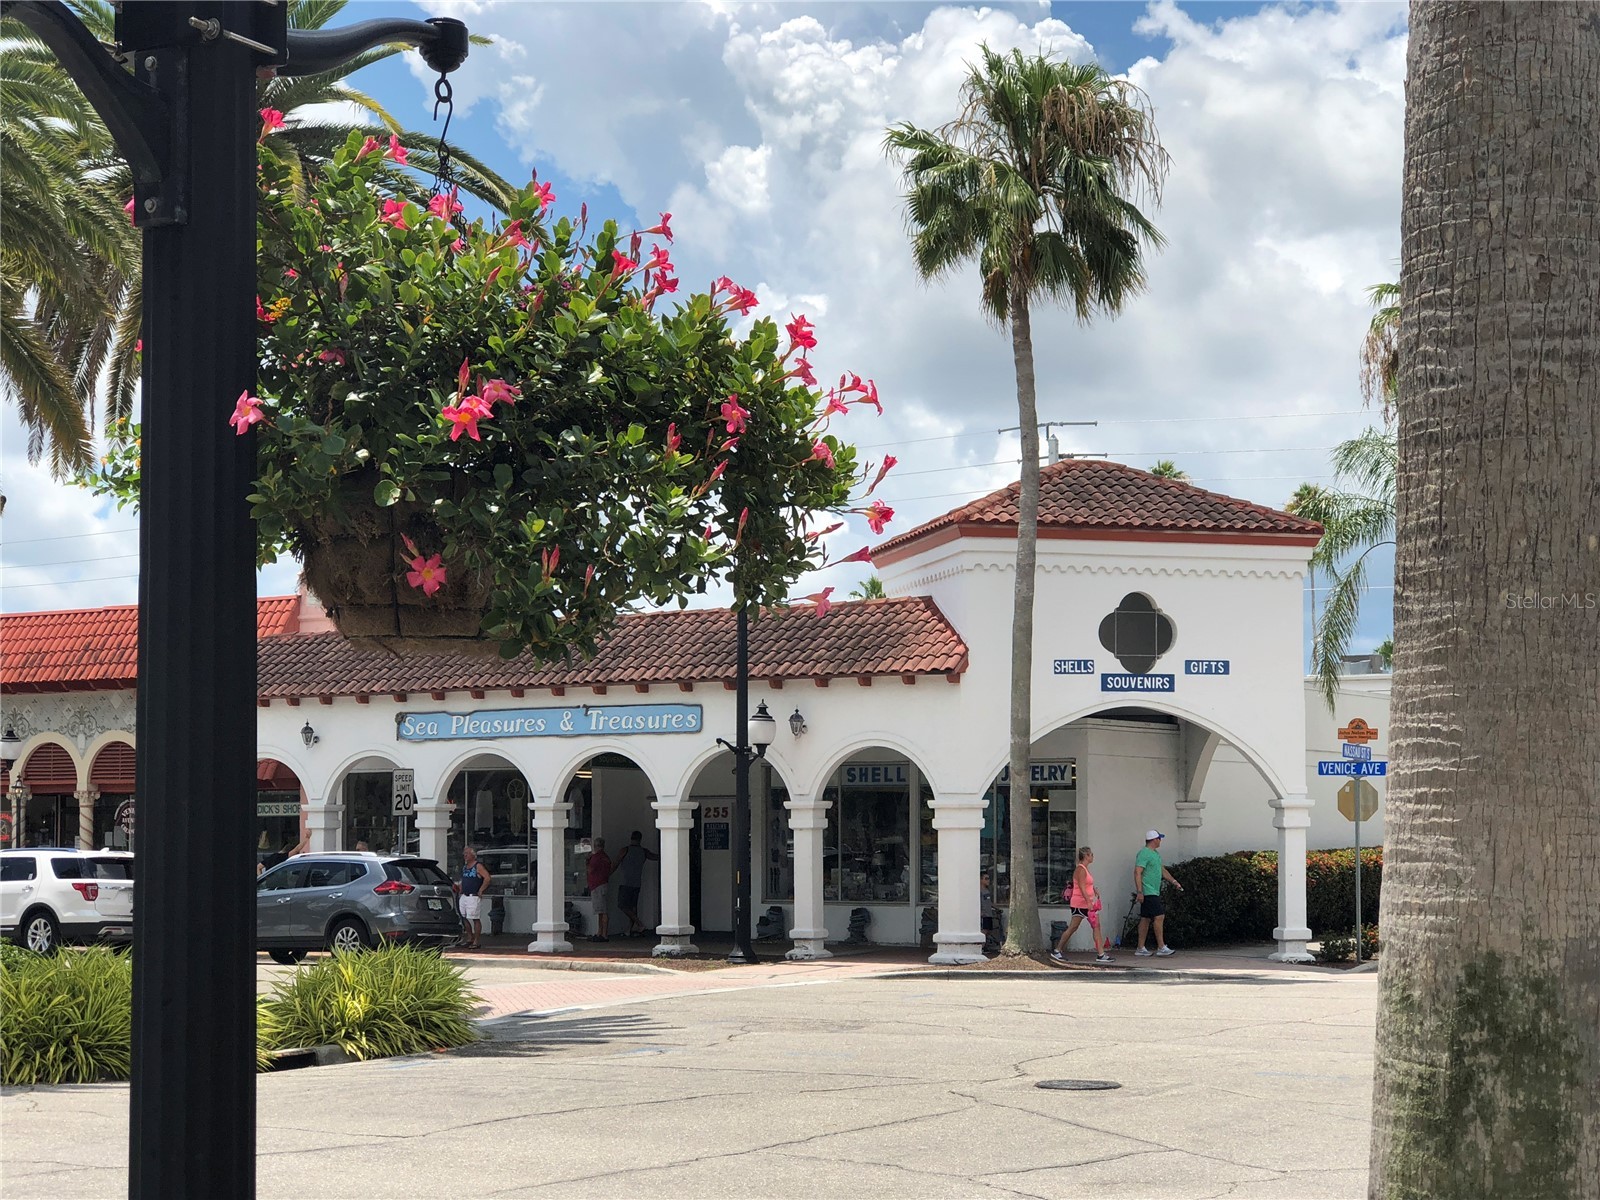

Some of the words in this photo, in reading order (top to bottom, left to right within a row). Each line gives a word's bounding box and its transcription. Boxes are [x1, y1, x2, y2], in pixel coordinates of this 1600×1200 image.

[1054, 660, 1094, 673] SHELLS
[1190, 661, 1225, 674] GIFTS
[1106, 676, 1170, 690] SOUVENIRS
[402, 716, 438, 736] Sea
[450, 714, 547, 735] Pleasures
[559, 710, 574, 732] &
[587, 709, 698, 731] Treasures
[846, 766, 907, 783] SHELL
[1001, 765, 1068, 781] JELRY
[1321, 763, 1357, 775] VENICE
[1360, 762, 1381, 775] AVE
[395, 774, 413, 783] SPEED
[396, 784, 410, 792] LIMIT
[395, 793, 412, 811] 20
[704, 806, 729, 818] 255
